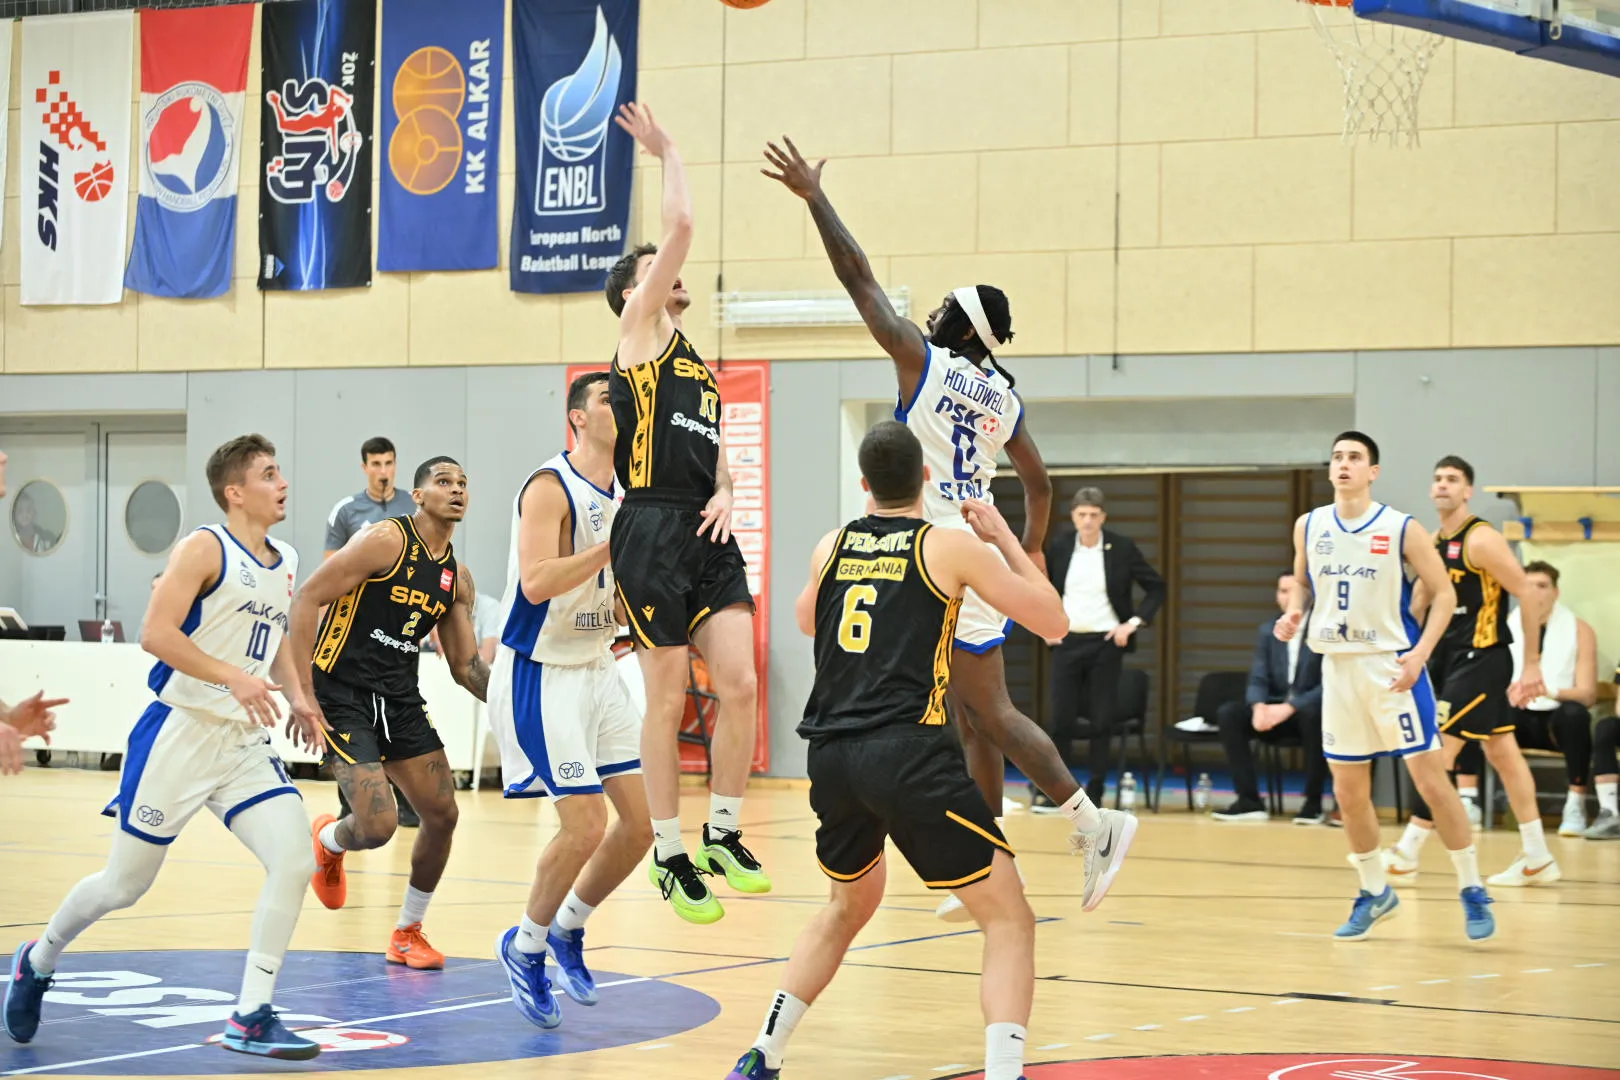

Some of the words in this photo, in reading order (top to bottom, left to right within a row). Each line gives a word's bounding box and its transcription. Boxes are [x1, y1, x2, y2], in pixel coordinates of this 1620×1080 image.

[341, 52, 359, 87] ŽOK
[467, 38, 490, 142] ALKAR
[465, 150, 486, 194] KK
[542, 164, 598, 209] ENBL
[38, 140, 60, 252] HKS
[530, 229, 579, 248] uropean
[581, 224, 621, 244] North
[699, 386, 719, 423] 10
[943, 367, 1006, 416] HOLLOWELL
[934, 395, 985, 430] PSK
[951, 424, 981, 481] 0
[1319, 564, 1378, 581] ALKAR
[389, 585, 447, 620] SPLIT
[1337, 580, 1350, 611] 9
[401, 611, 422, 637] 2
[575, 610, 603, 628] HOTEL
[837, 583, 879, 654] 6
[245, 620, 272, 662] 10
[1398, 712, 1417, 744] 9
